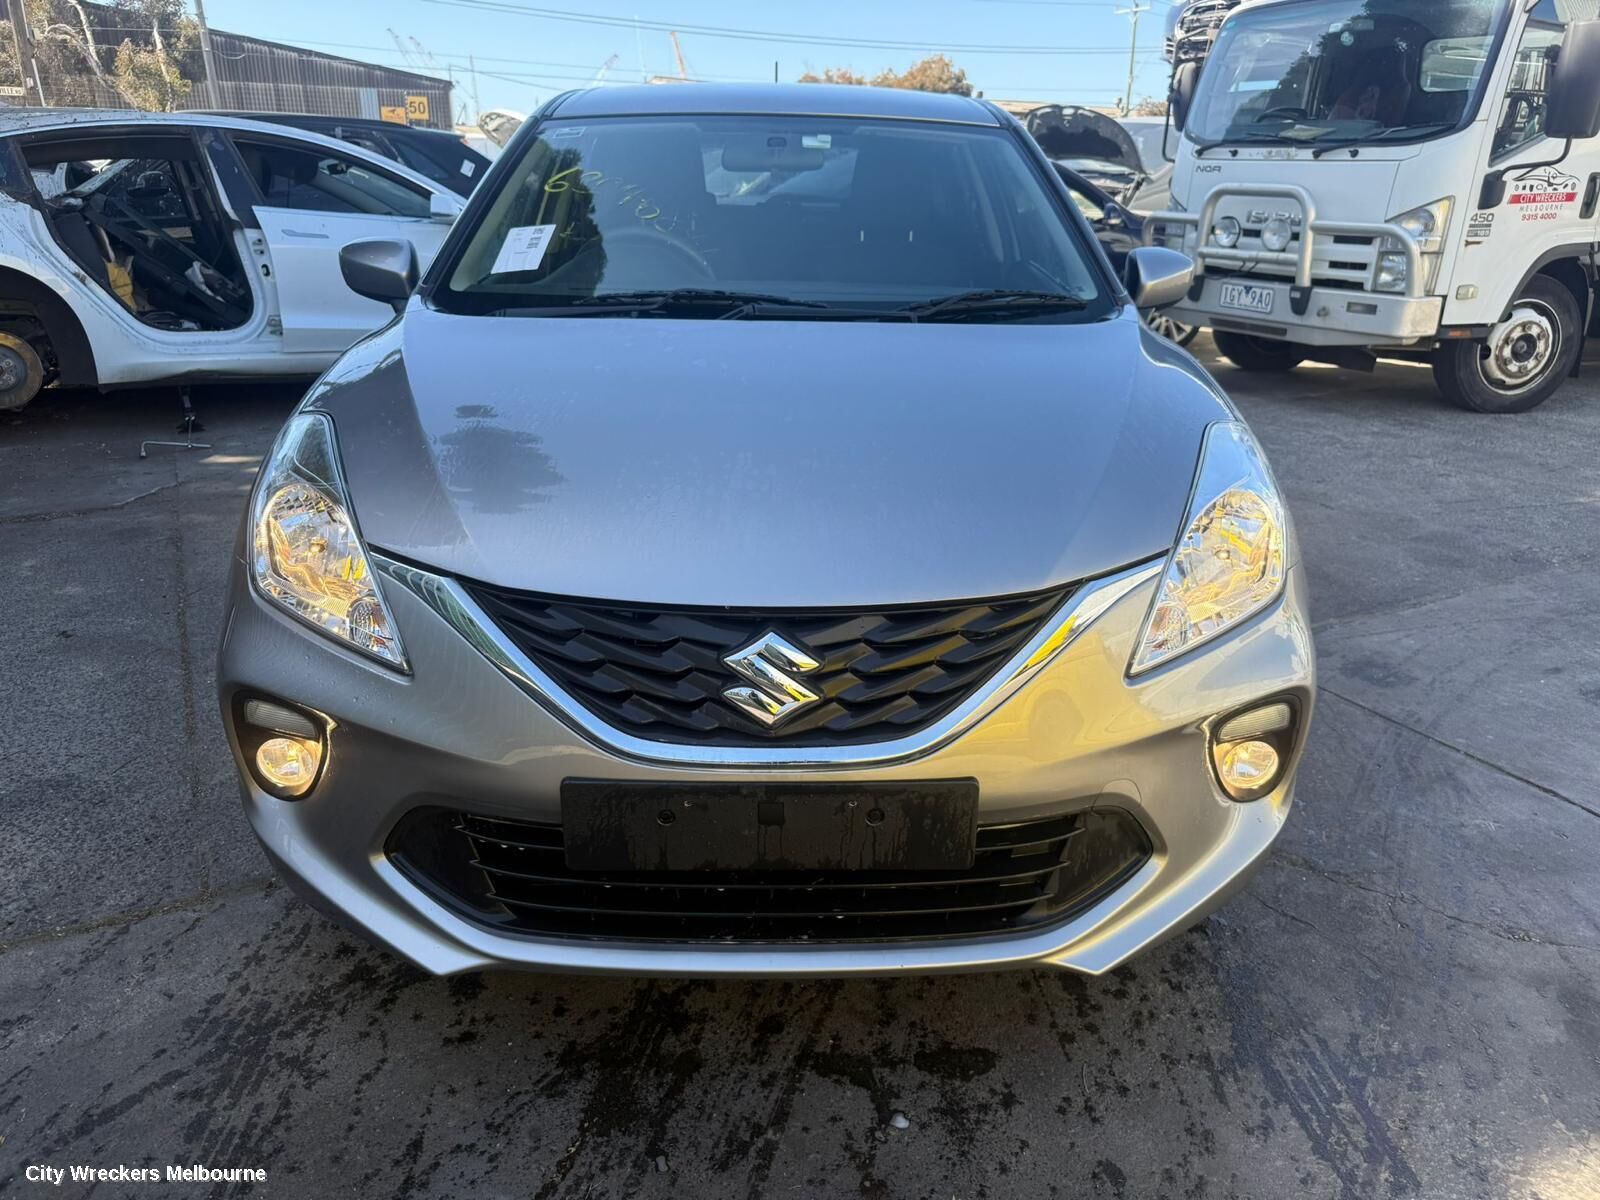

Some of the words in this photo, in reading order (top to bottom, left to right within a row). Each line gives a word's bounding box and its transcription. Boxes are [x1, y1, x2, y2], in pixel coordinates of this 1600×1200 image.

[409, 101, 426, 115] 50
[1520, 194, 1534, 203] CITY
[1535, 192, 1567, 202] WRECKERS
[1519, 203, 1564, 212] MELBOURNE
[1470, 212, 1495, 223] 450
[1521, 213, 1538, 221] 9315
[1539, 212, 1557, 220] 4000
